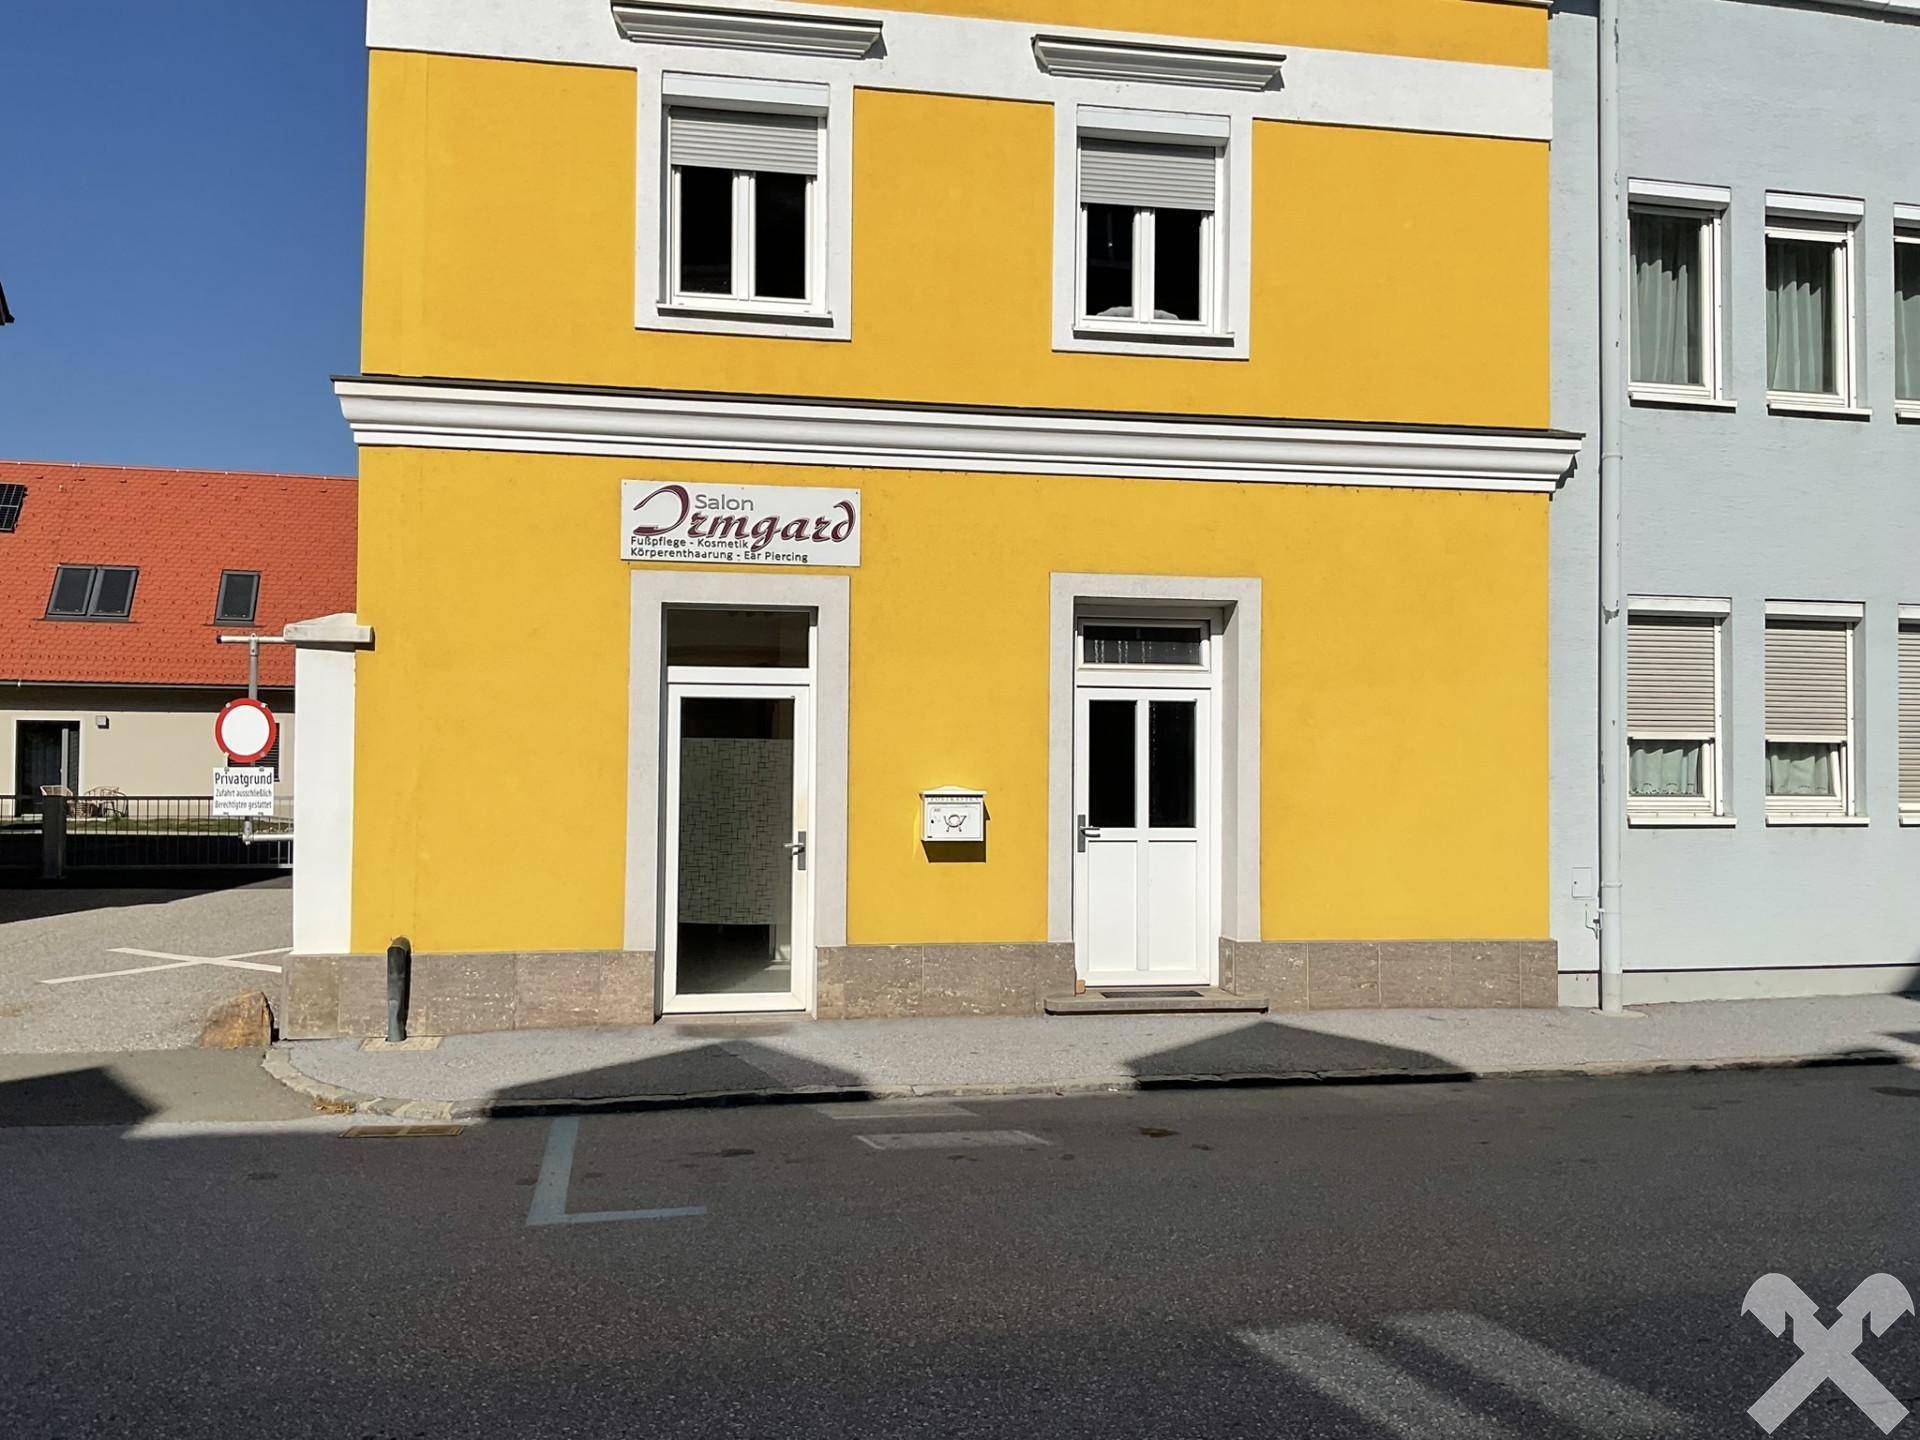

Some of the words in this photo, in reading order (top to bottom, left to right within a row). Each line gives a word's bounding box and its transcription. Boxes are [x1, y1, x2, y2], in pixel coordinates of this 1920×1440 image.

[695, 494, 754, 511] Salon
[633, 485, 857, 552] Irmgard
[631, 536, 686, 547] Fußpflege
[697, 538, 749, 549] Kosmetik
[631, 548, 733, 561] Körperenthaarung
[744, 551, 761, 560] Ear
[765, 553, 808, 563] Piercing
[215, 772, 272, 787] Privatgrund
